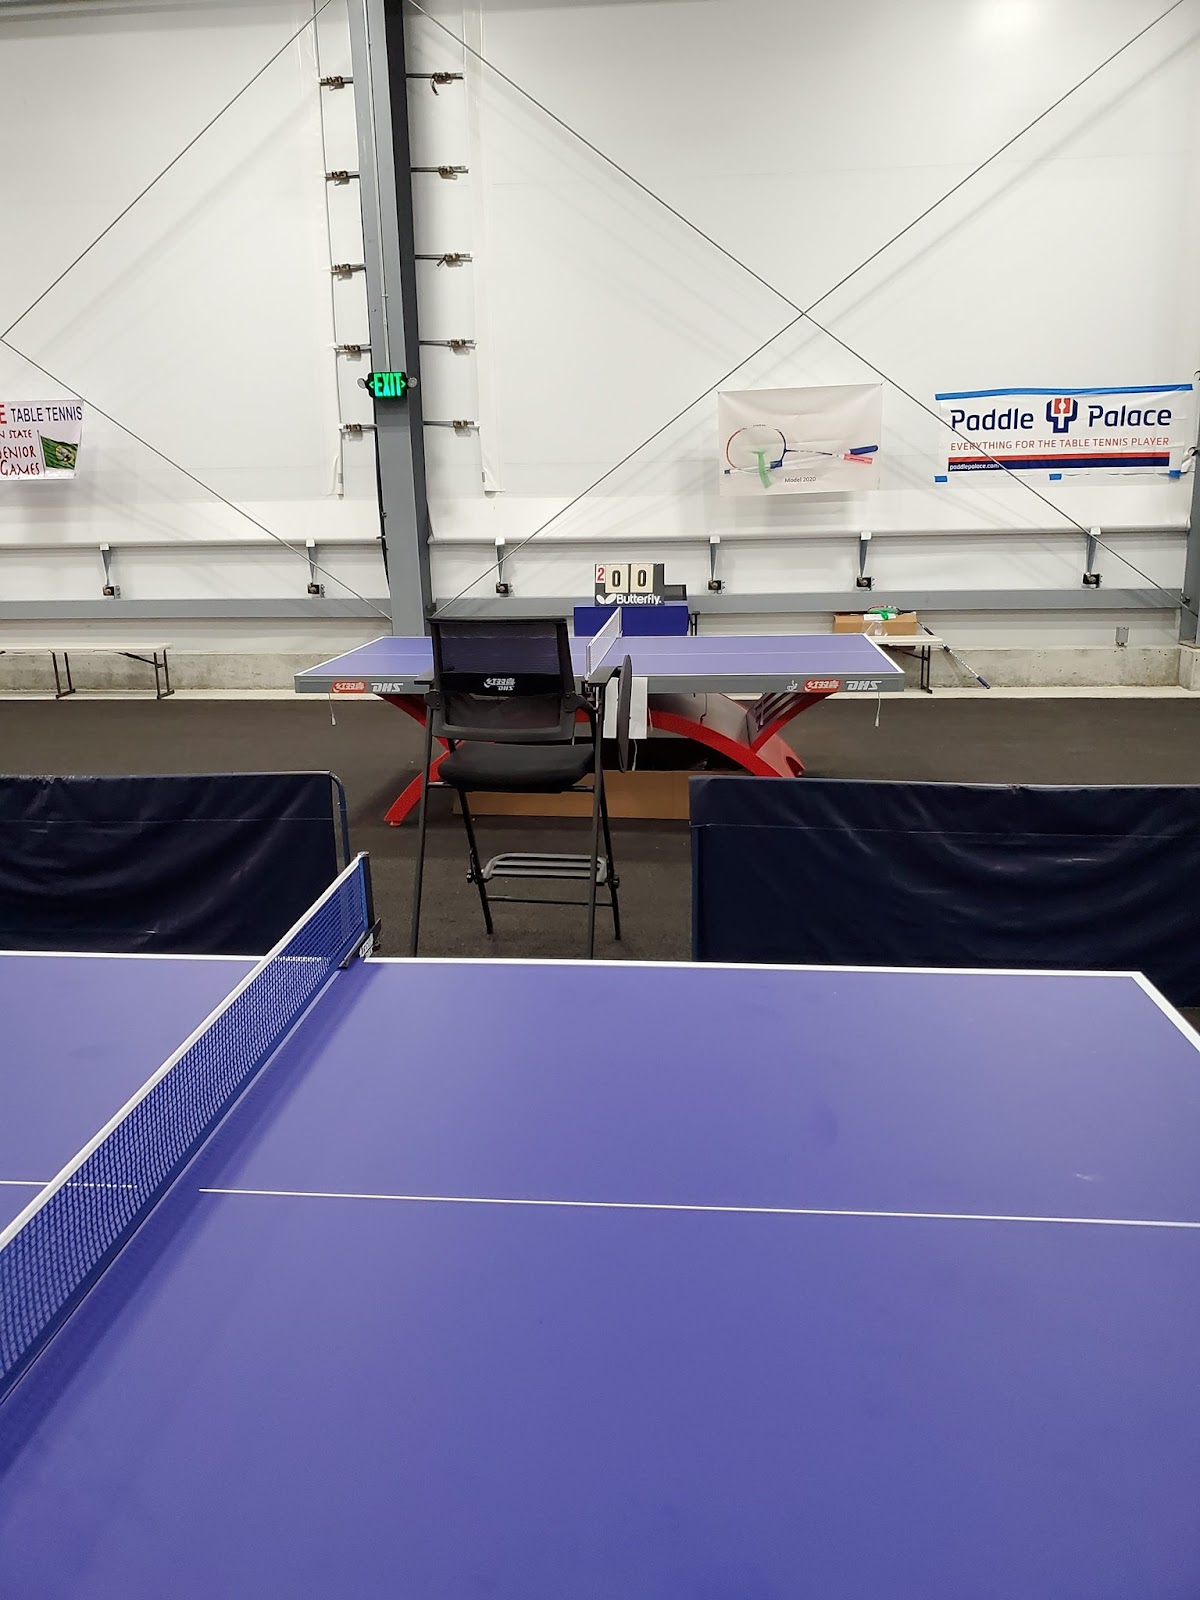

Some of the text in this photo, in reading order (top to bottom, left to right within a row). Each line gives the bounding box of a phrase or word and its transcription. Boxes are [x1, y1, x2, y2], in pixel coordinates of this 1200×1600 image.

[374, 373, 402, 397] EXIT
[10, 407, 44, 423] TABLE
[45, 406, 83, 421] TENNIS
[950, 404, 1172, 432] Paddle Palace
[9, 429, 33, 439] STATE
[950, 437, 1169, 451] EVERYTHING FOR THE TABLE TENNIS PLAYER
[949, 462, 1000, 472] paddlepalace.com
[597, 567, 647, 587] 2 0 0
[370, 682, 404, 693] DHS
[846, 680, 882, 691] DHS
